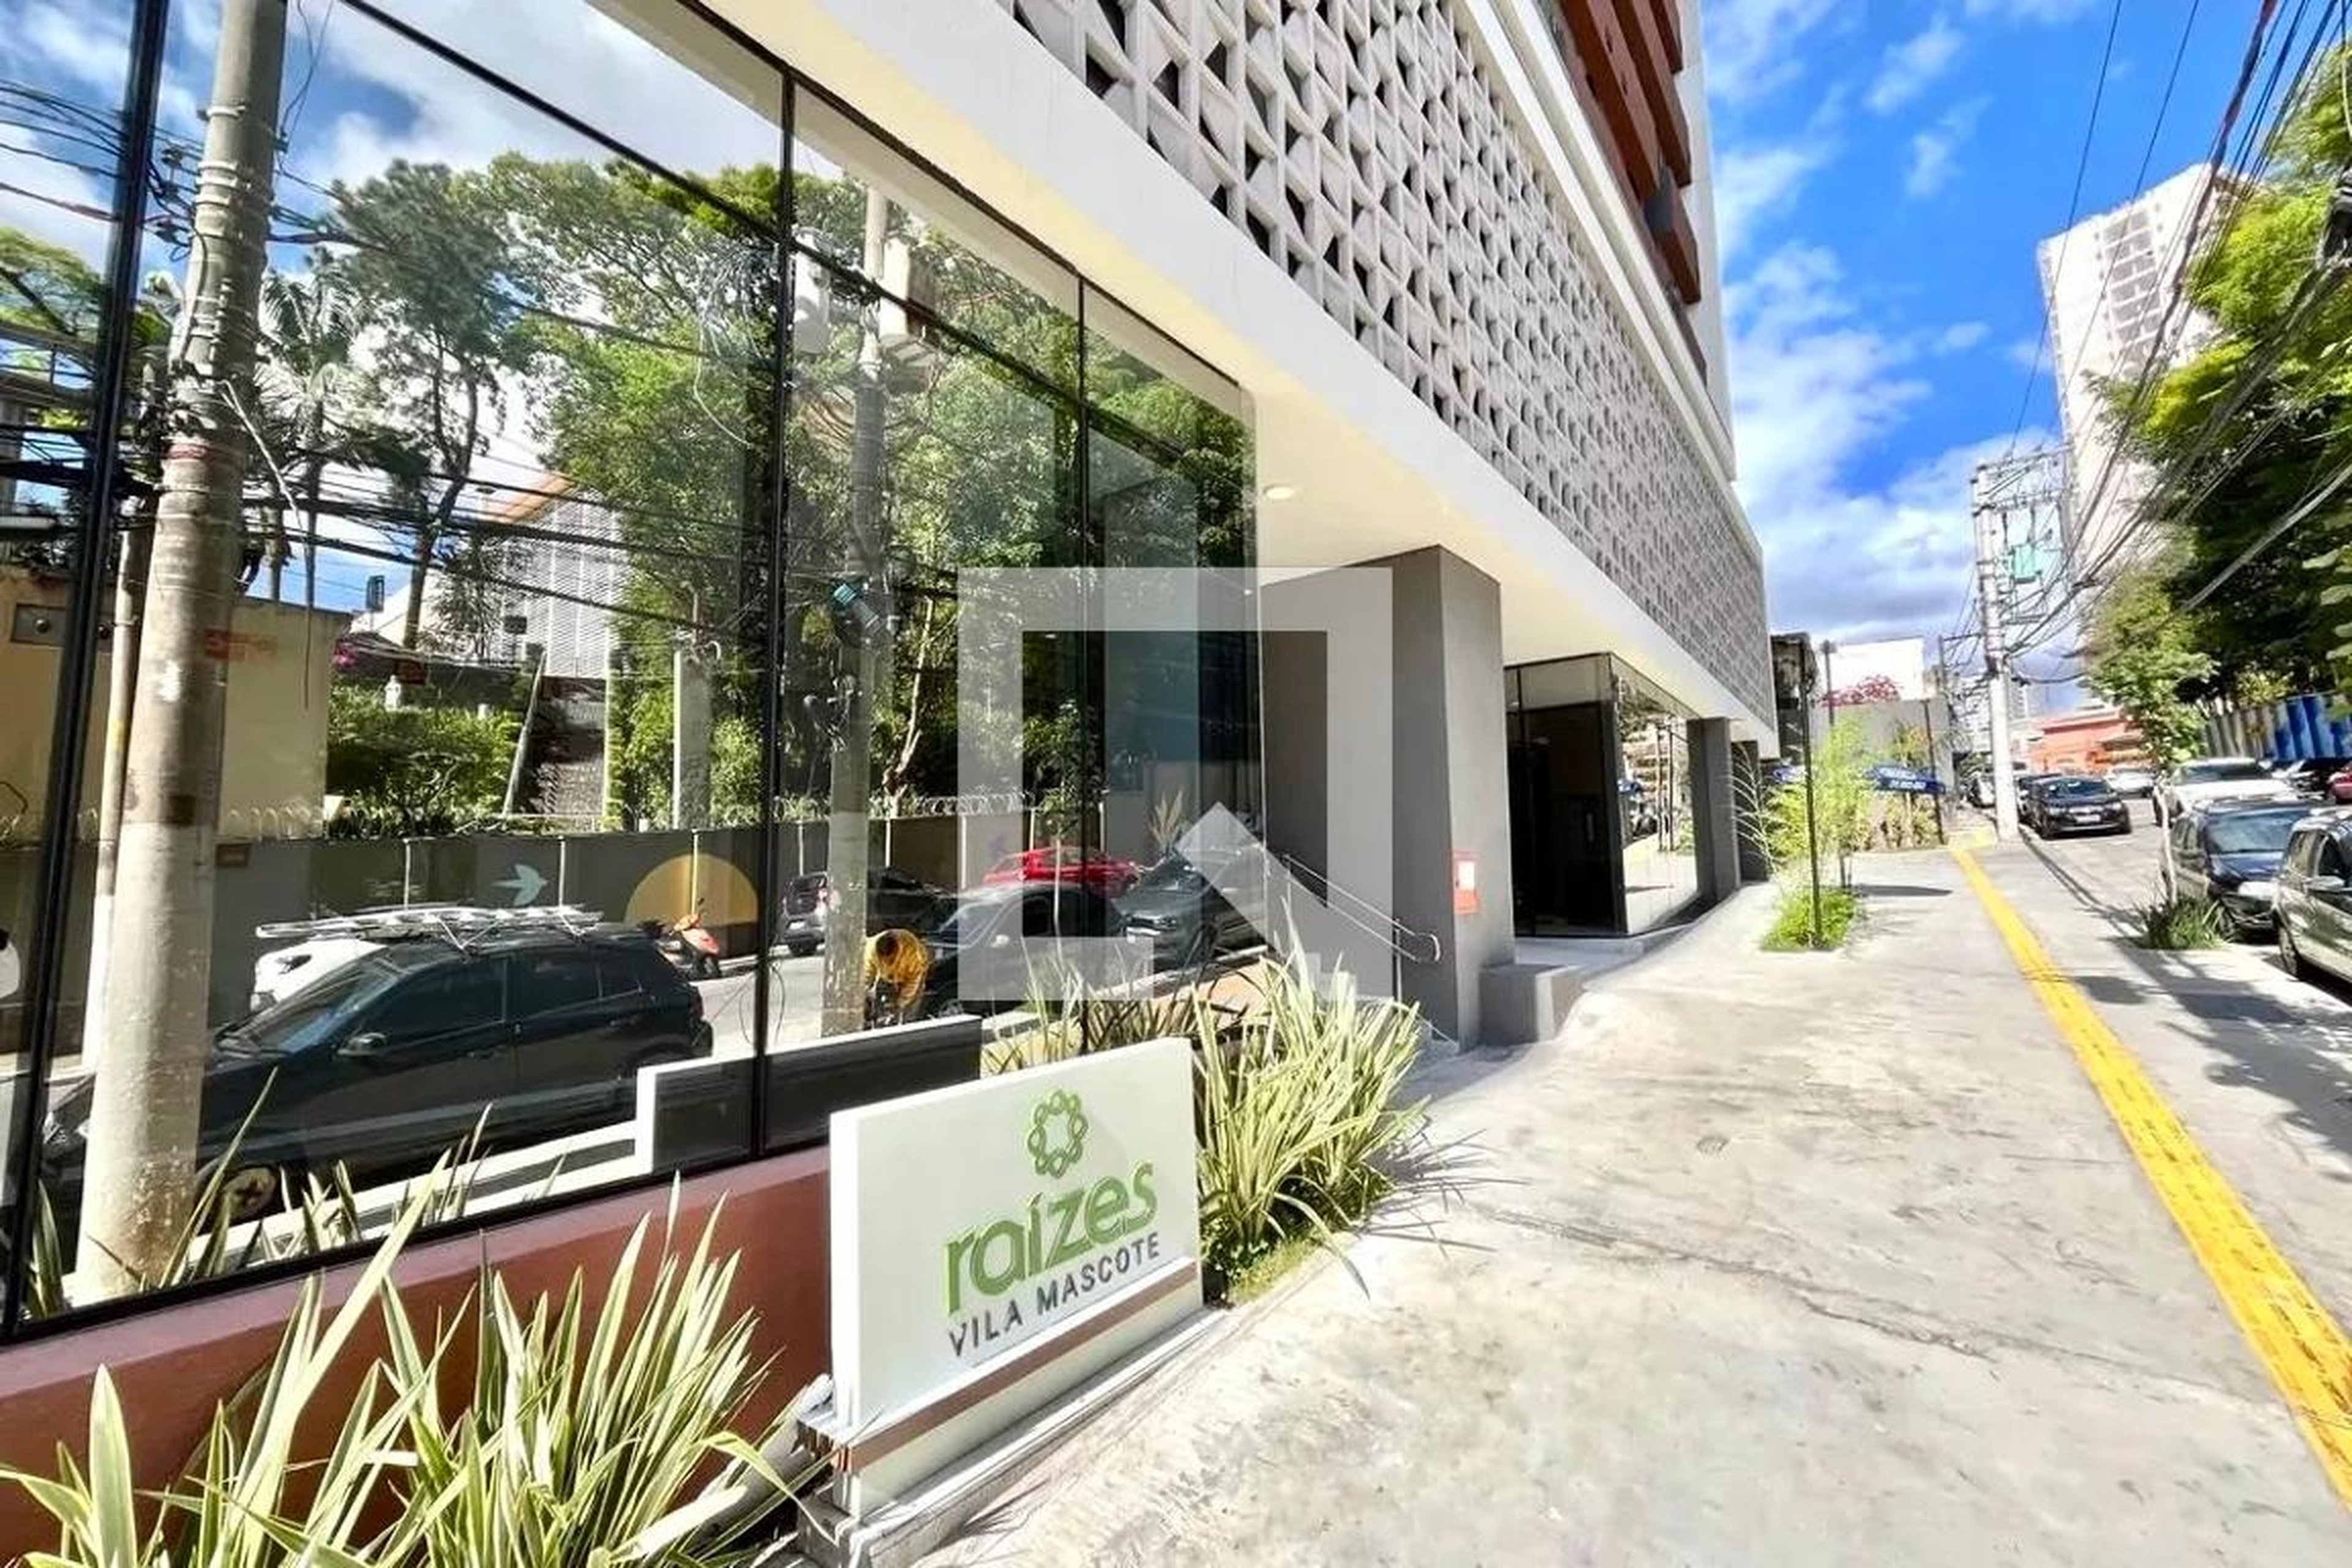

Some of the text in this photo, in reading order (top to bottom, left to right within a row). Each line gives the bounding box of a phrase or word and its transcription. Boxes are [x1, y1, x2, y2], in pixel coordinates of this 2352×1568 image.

[946, 1161, 1157, 1316] raízes
[949, 1231, 1160, 1357] VILA MASCOTE
